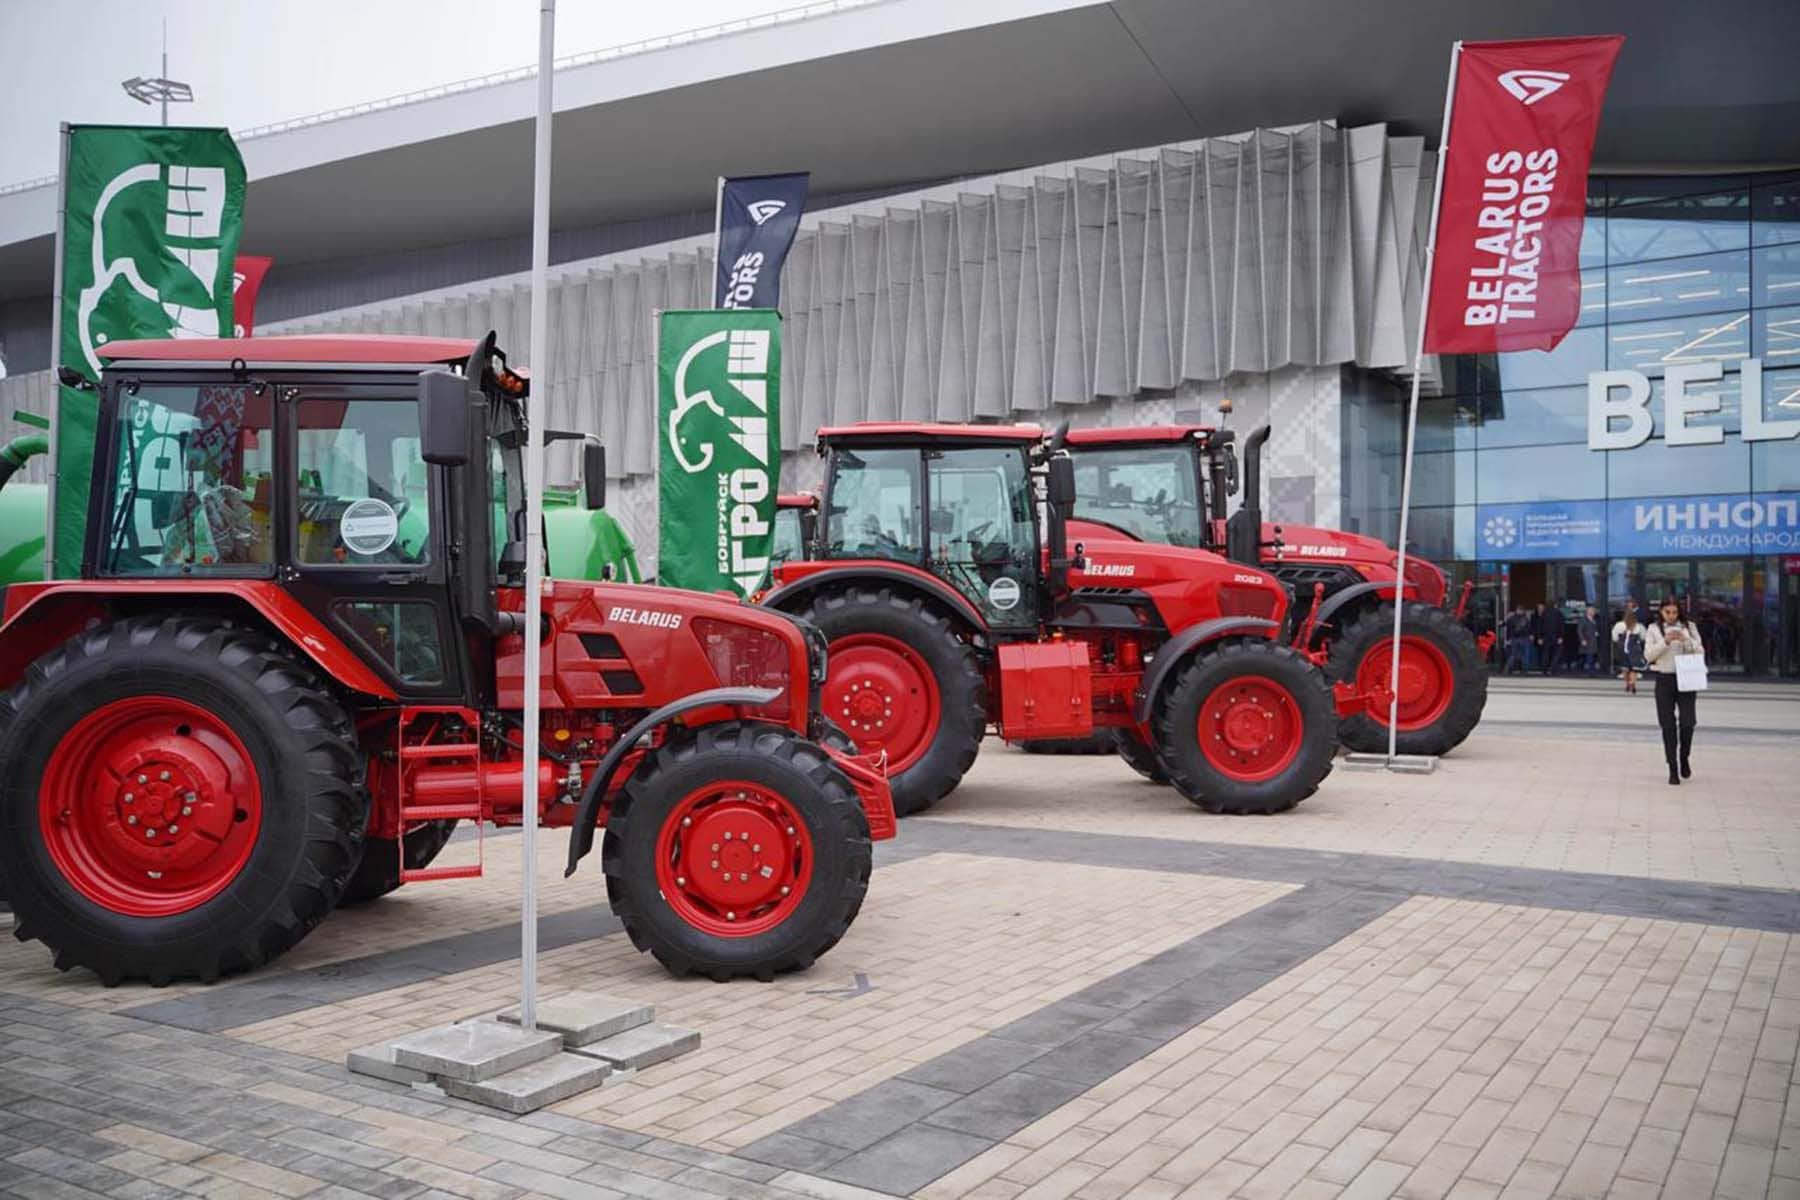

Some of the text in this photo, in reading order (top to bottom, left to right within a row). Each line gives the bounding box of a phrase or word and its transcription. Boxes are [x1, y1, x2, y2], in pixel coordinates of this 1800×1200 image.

[1464, 150, 1523, 326] BELARUS
[1499, 147, 1559, 325] TRACTORS
[717, 472, 729, 574] БОБРУЙСК
[1634, 500, 1797, 532] ИННОП
[1300, 544, 1347, 557] BELARUS
[608, 606, 683, 630] BELARUS
